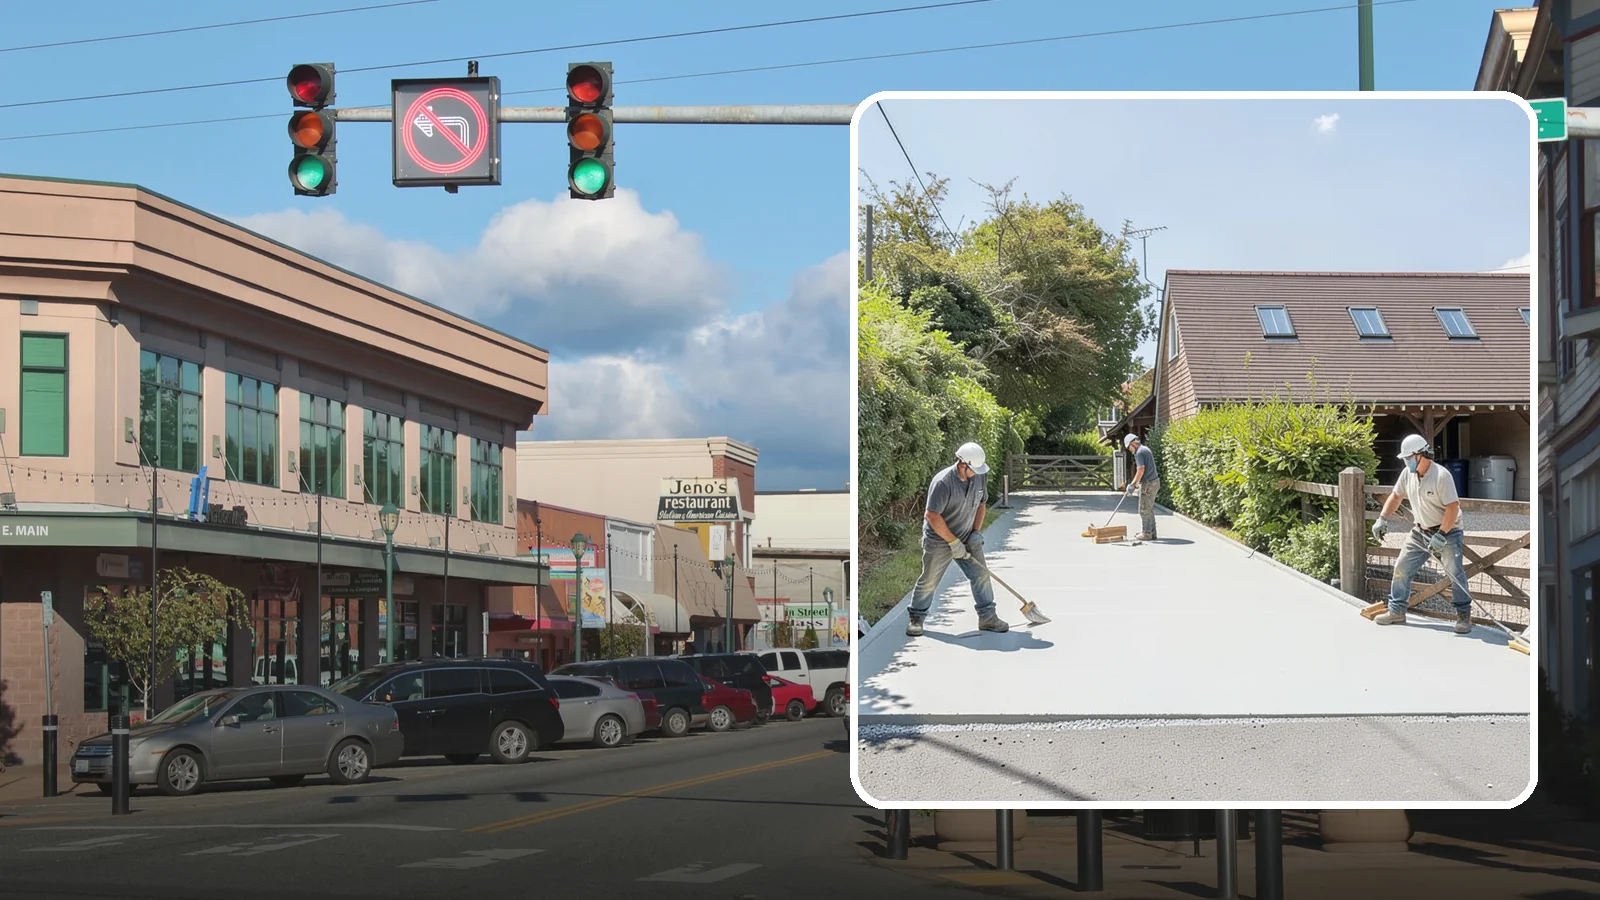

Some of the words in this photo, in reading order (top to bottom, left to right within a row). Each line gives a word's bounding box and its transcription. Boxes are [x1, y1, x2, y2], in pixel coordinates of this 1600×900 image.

[670, 480, 727, 494] Jeno's
[665, 497, 731, 509] restaurant
[659, 510, 681, 519] Italian
[686, 510, 714, 519] American
[715, 510, 737, 519] Cuisine
[2, 525, 12, 536] E.
[16, 525, 48, 536] MAIN
[786, 607, 795, 616] in
[798, 608, 828, 616] Street
